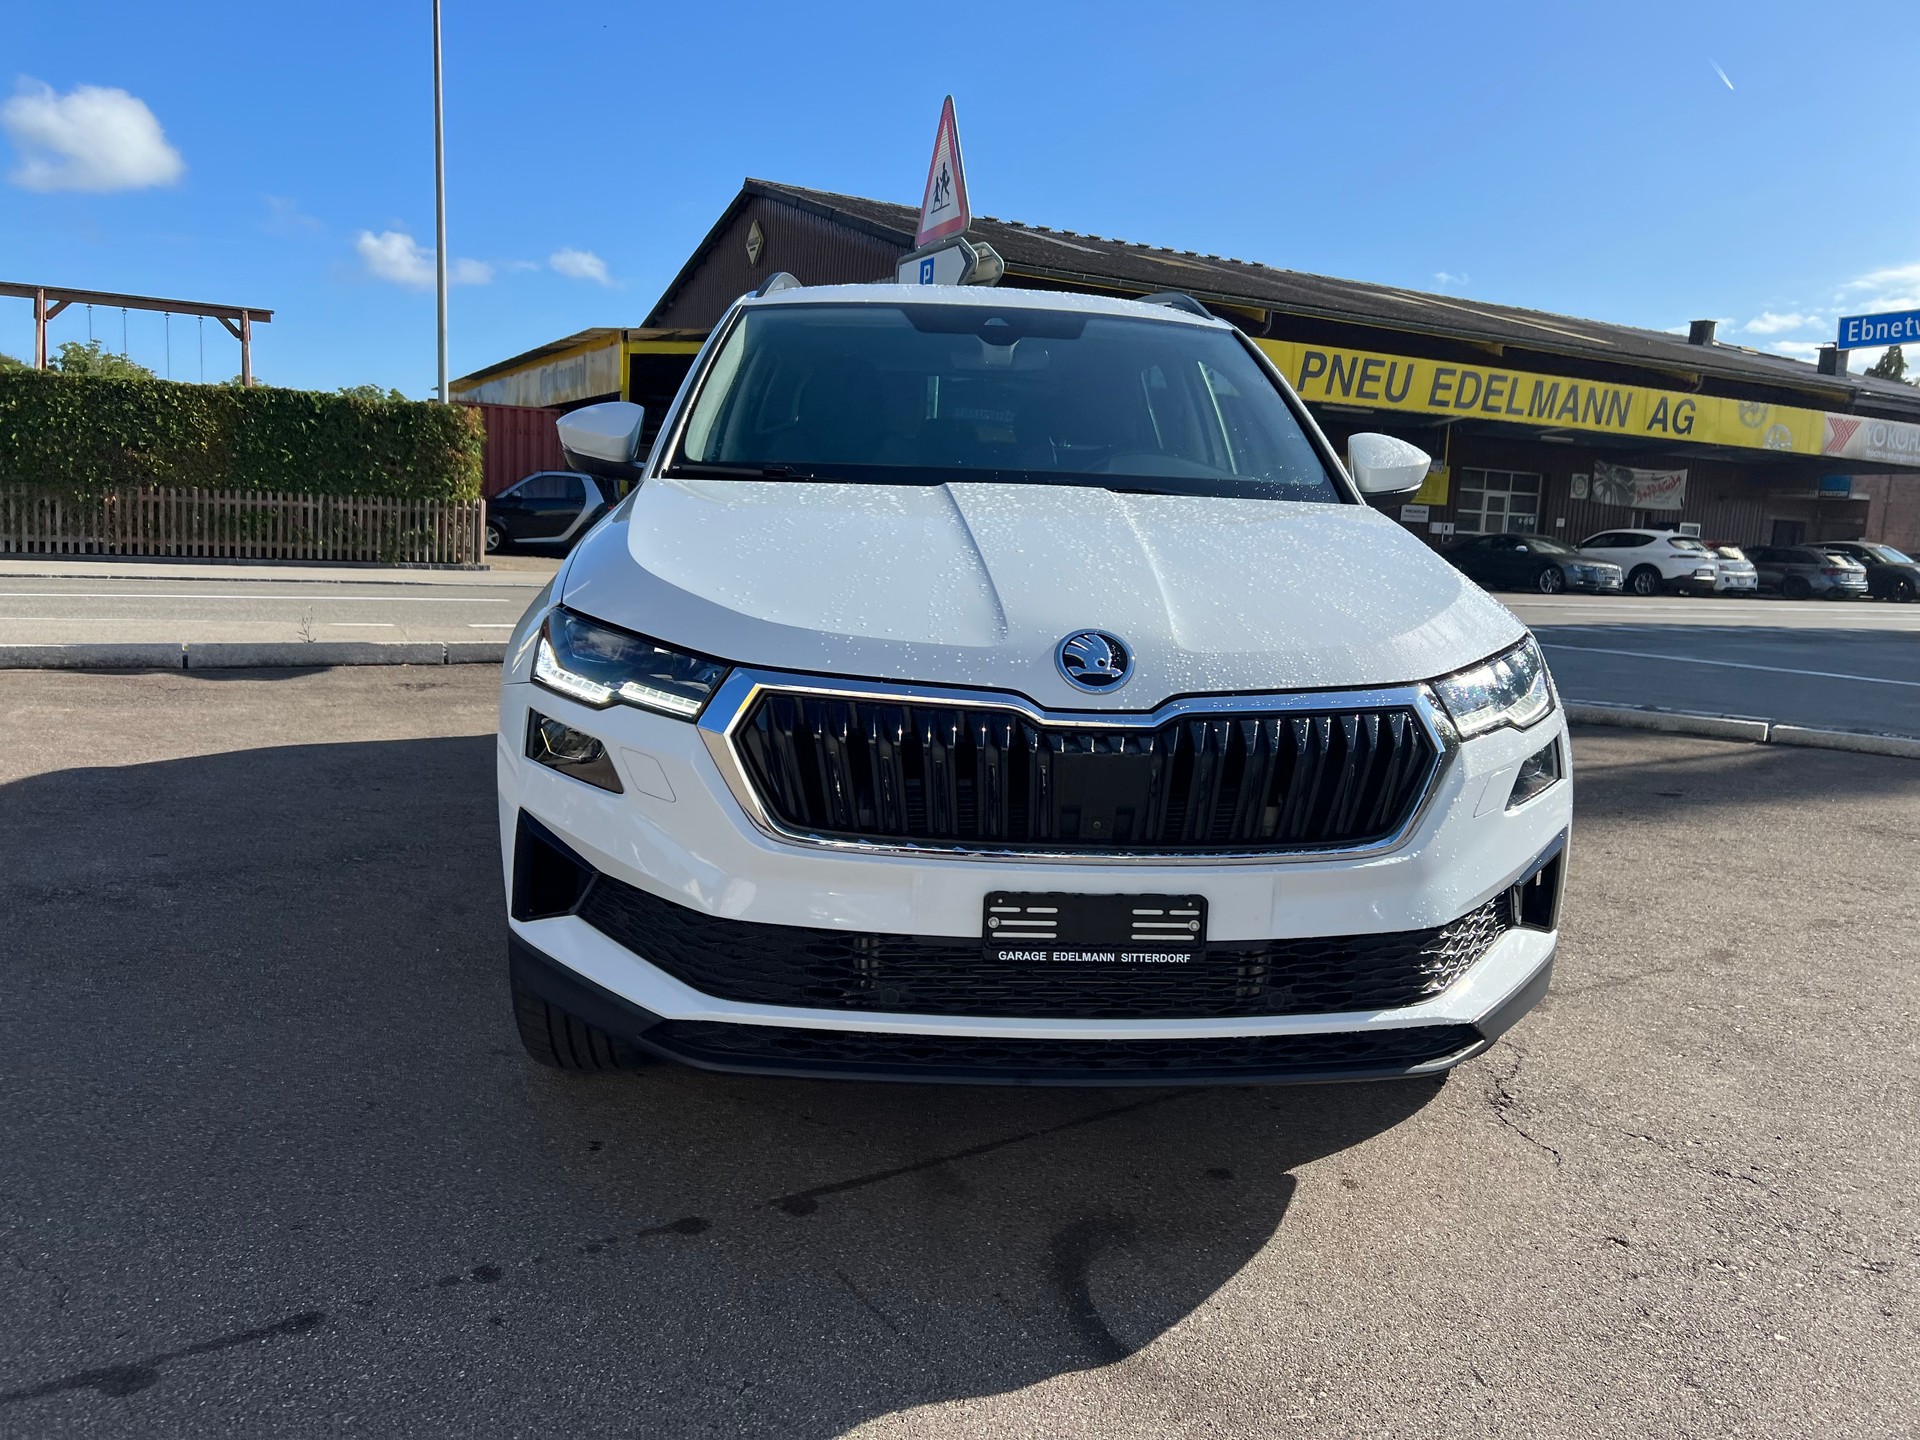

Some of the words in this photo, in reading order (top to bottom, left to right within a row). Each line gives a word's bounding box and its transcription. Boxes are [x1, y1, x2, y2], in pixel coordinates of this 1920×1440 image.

[923, 264, 931, 284] P
[1296, 350, 1414, 403] PNEU
[1428, 368, 1633, 428] EDELMANN
[1646, 396, 1697, 435] AG
[1866, 422, 1920, 452] YOKOH
[998, 950, 1047, 961] GARAGE
[1053, 951, 1115, 962] EDELMANN
[1121, 953, 1191, 963] SITTERDORF
